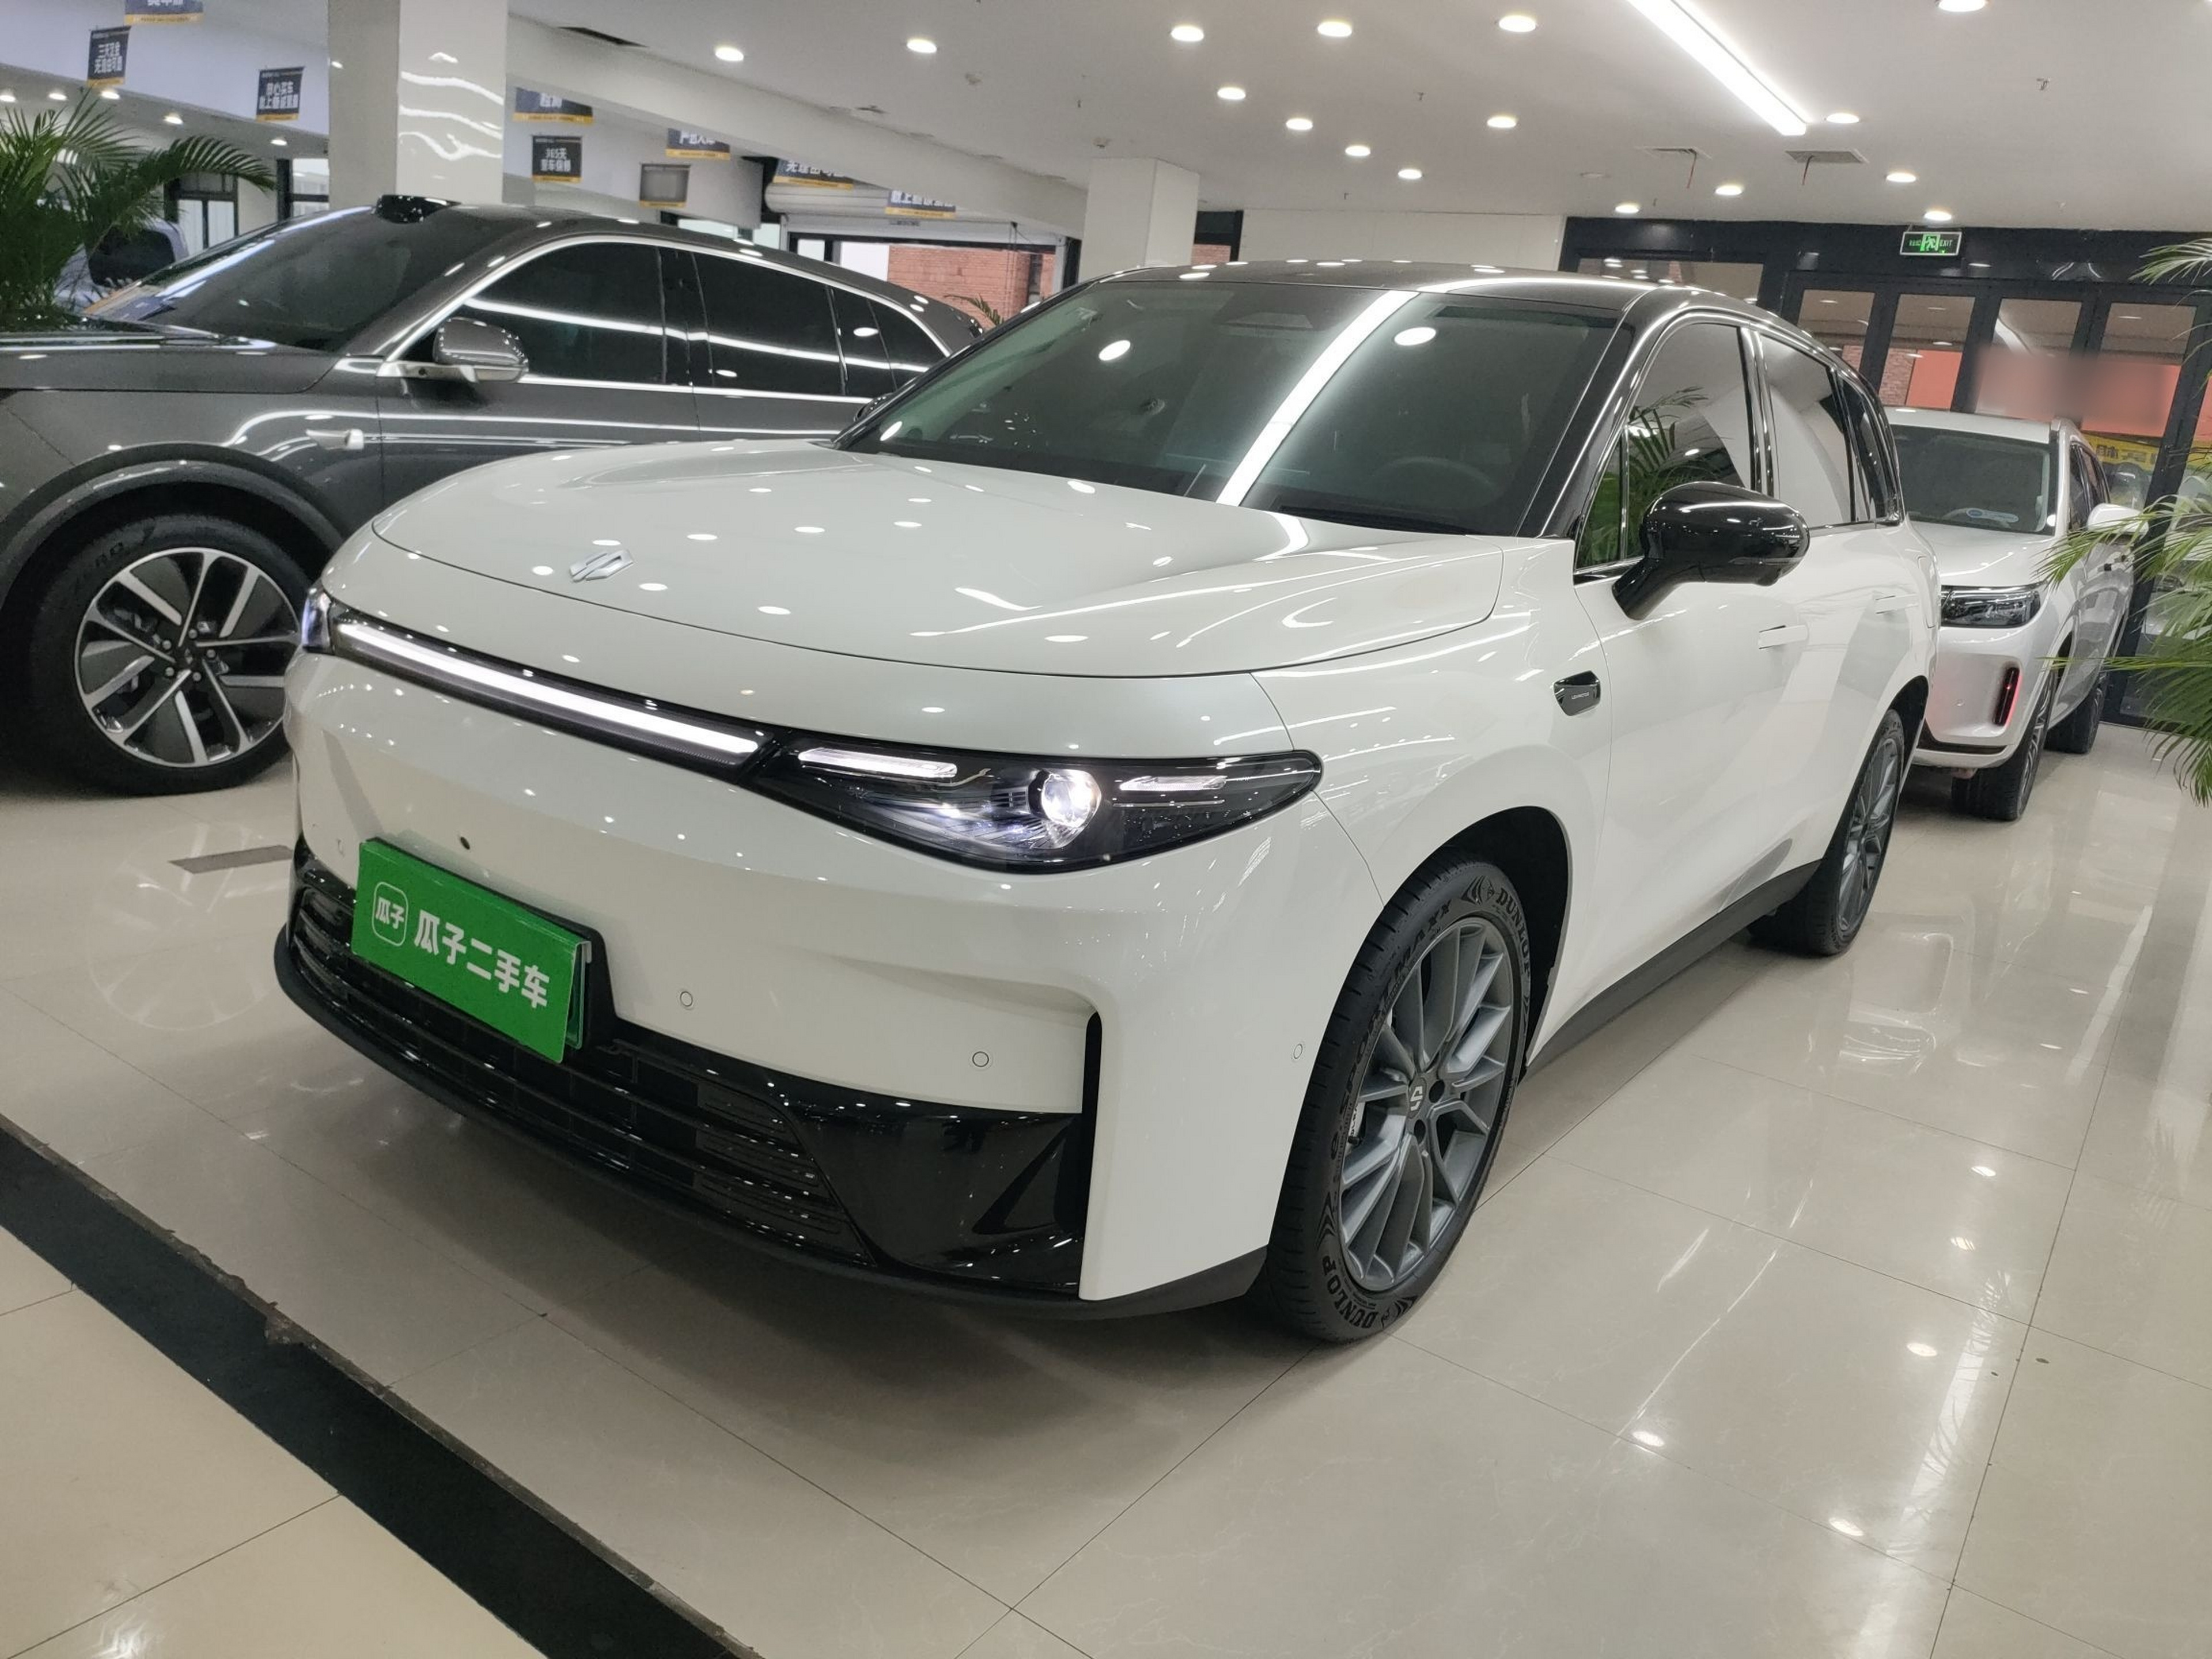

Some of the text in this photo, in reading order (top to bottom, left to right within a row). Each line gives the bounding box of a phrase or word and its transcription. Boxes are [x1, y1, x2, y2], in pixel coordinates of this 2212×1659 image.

[376, 897, 406, 930] 瓜子
[1496, 887, 1531, 978] DUNLOP
[414, 909, 551, 1009] 瓜子二手车
[1322, 1255, 1380, 1329] DUNLOP
